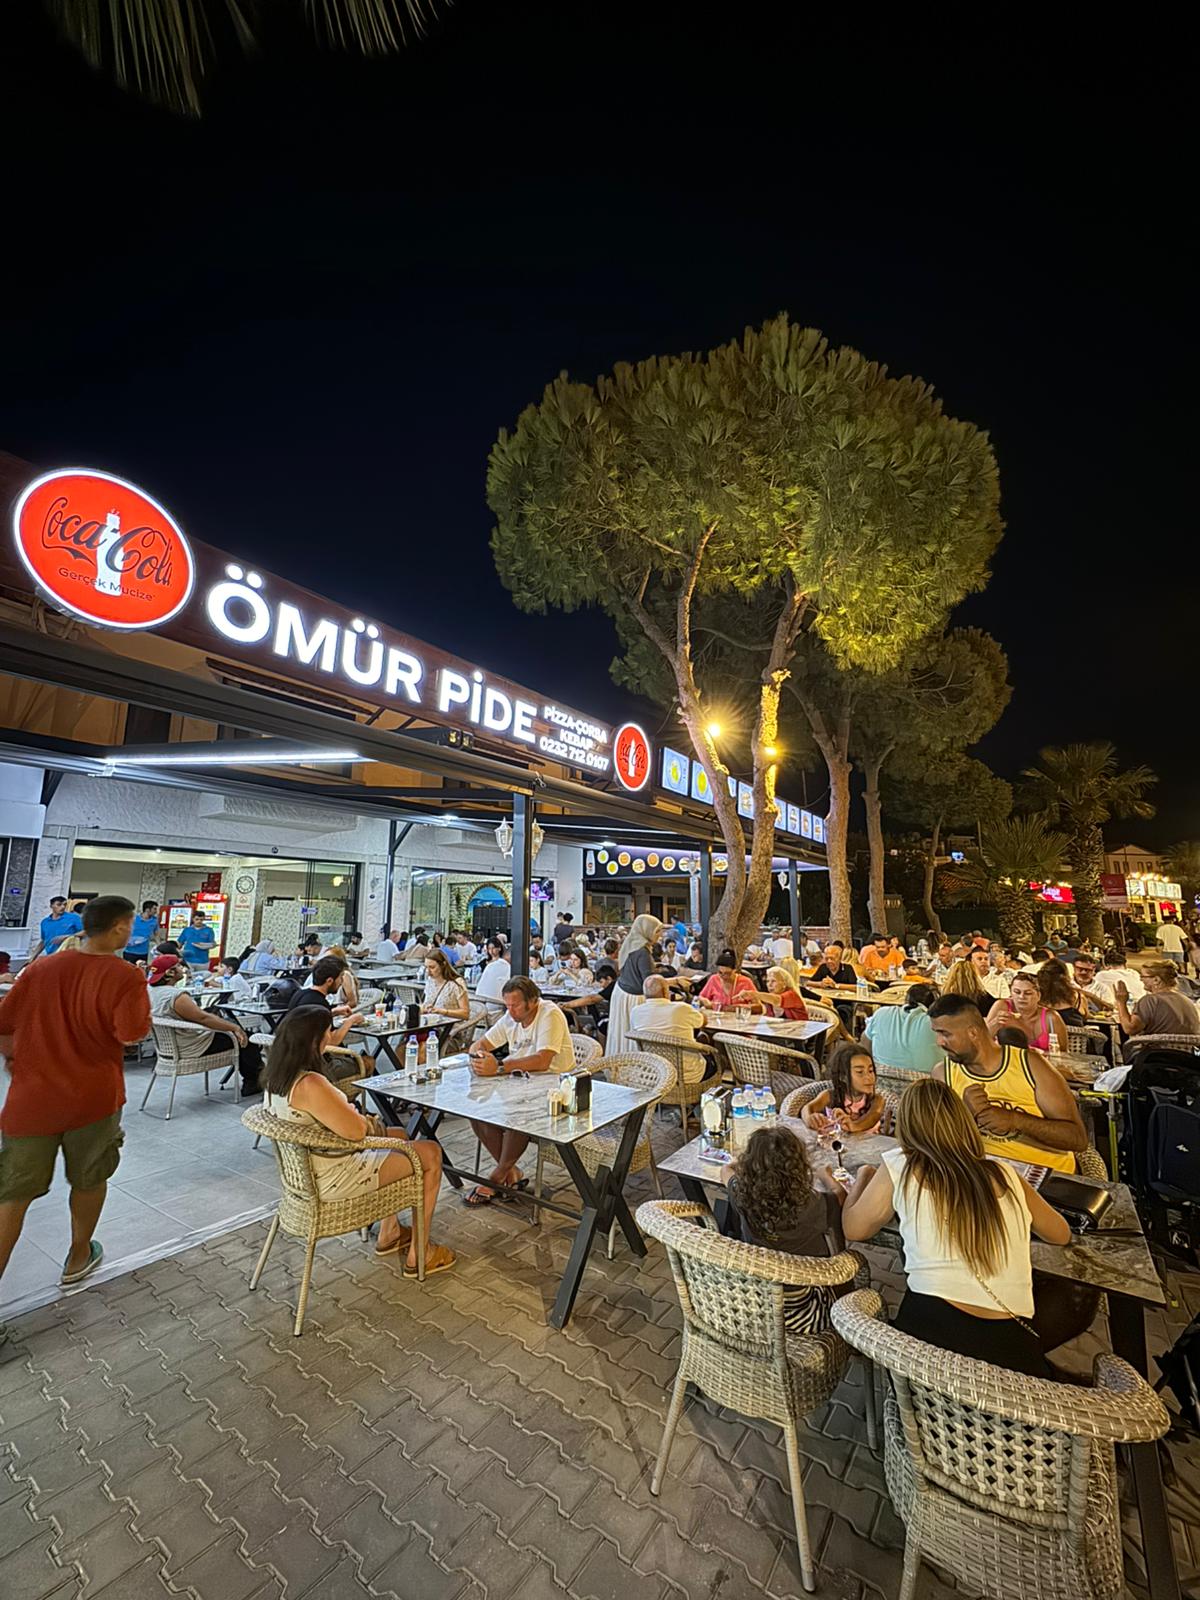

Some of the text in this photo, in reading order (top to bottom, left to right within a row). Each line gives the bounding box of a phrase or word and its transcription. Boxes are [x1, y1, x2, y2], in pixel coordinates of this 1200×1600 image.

[41, 496, 173, 586] Coca-Cola
[58, 567, 153, 602] Gerçek Mucize
[207, 563, 538, 744] ÖMÜR PİDE
[560, 729, 593, 751] KEBAP
